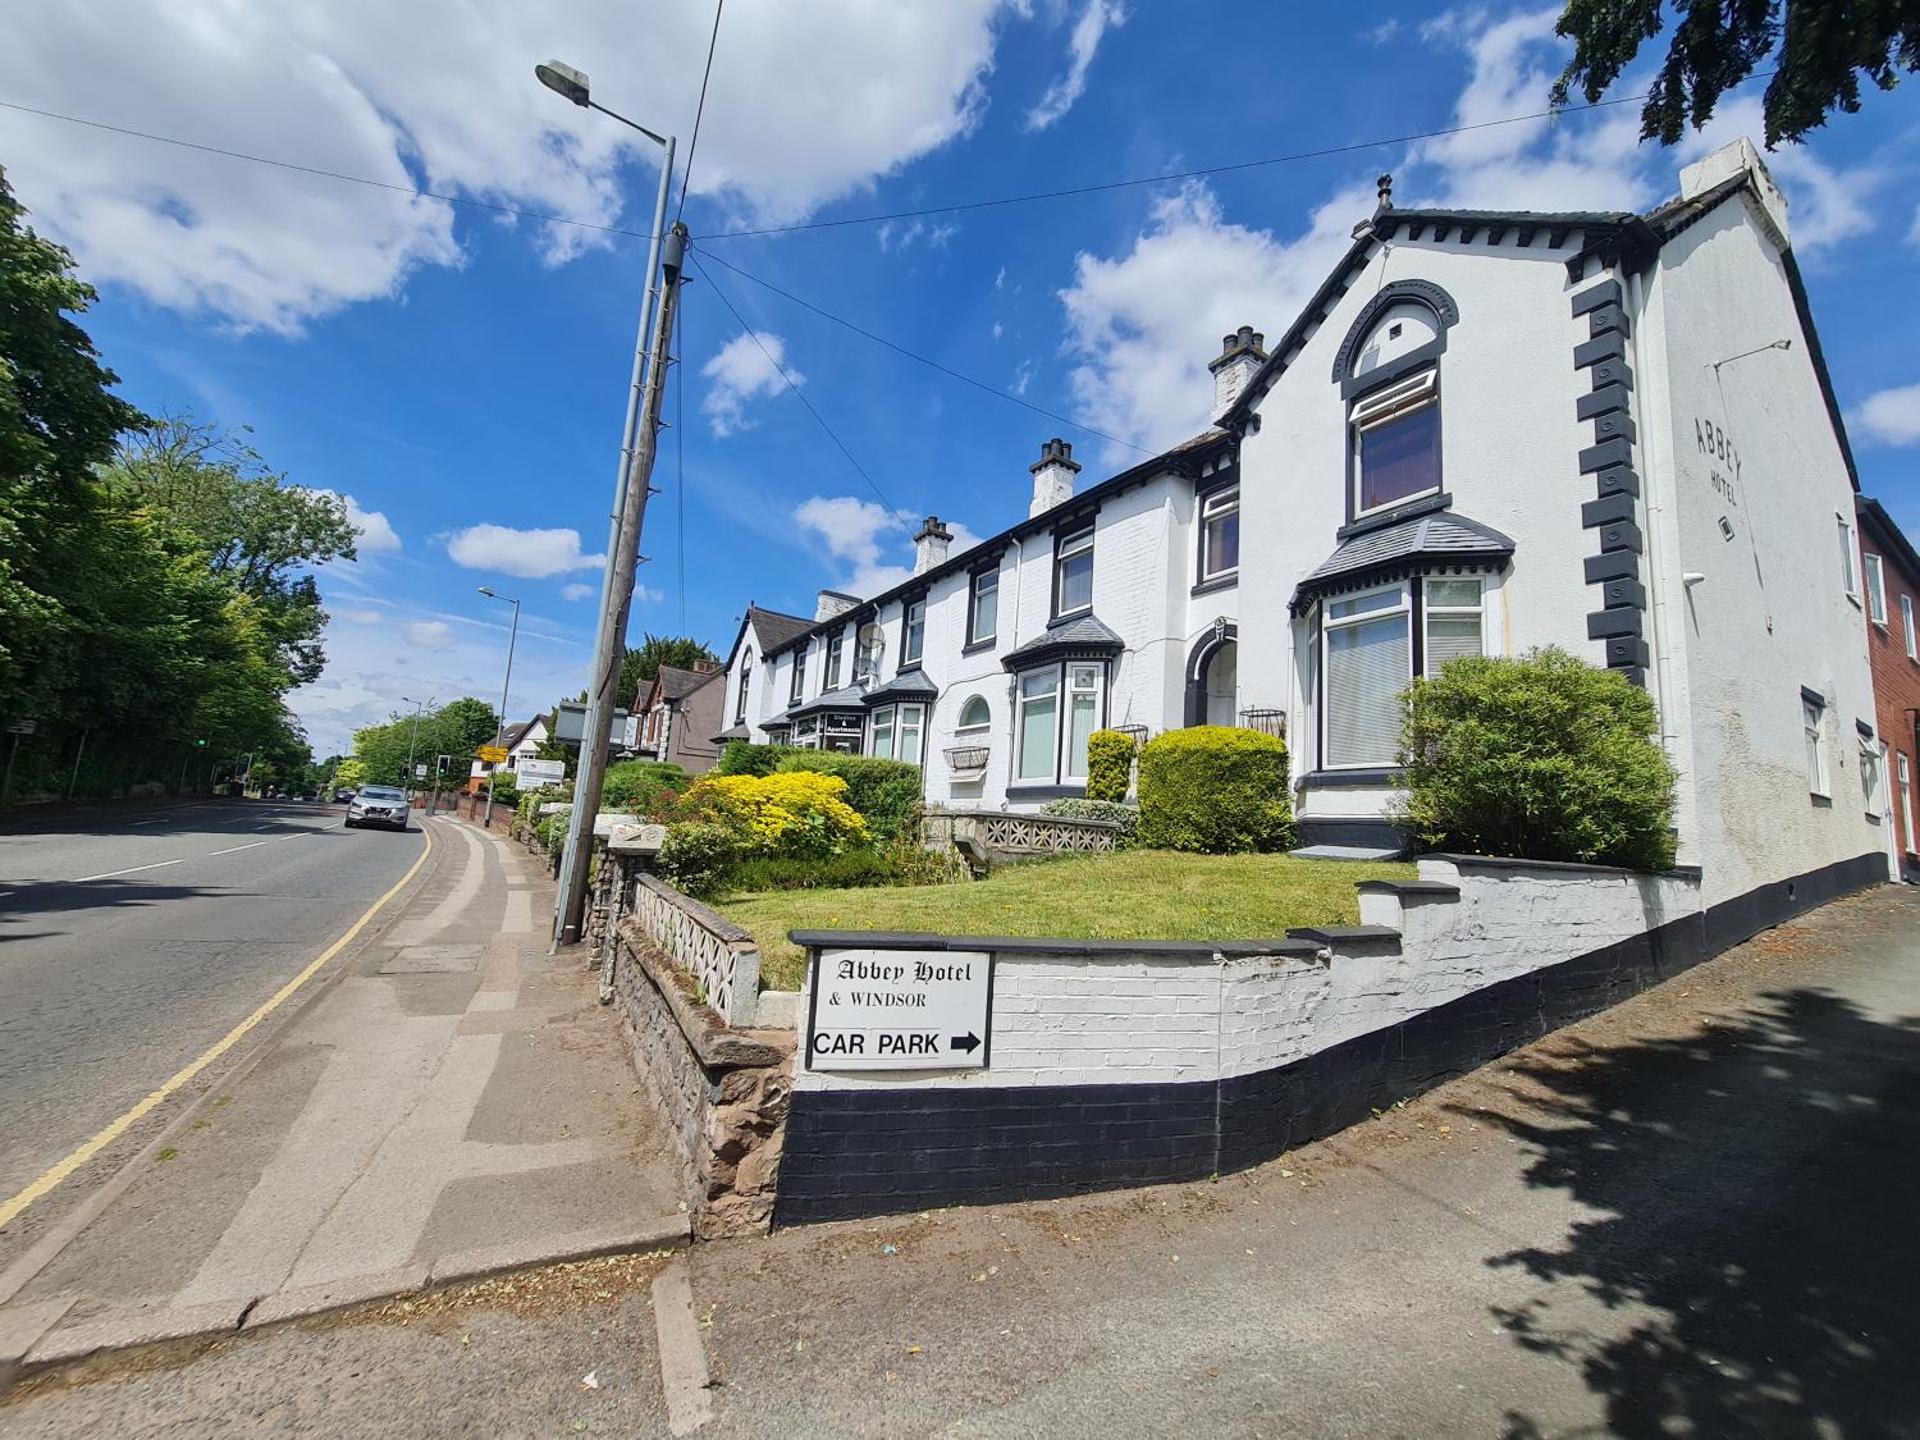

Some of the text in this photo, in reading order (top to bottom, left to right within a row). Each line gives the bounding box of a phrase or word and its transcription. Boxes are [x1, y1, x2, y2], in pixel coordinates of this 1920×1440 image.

[1694, 417, 1742, 481] ABBEY
[1711, 469, 1737, 507] HOTEL
[837, 960, 972, 985] Abbey Hotel
[829, 992, 926, 1007] & WINDSOR
[814, 1033, 940, 1054] CAR PARK
